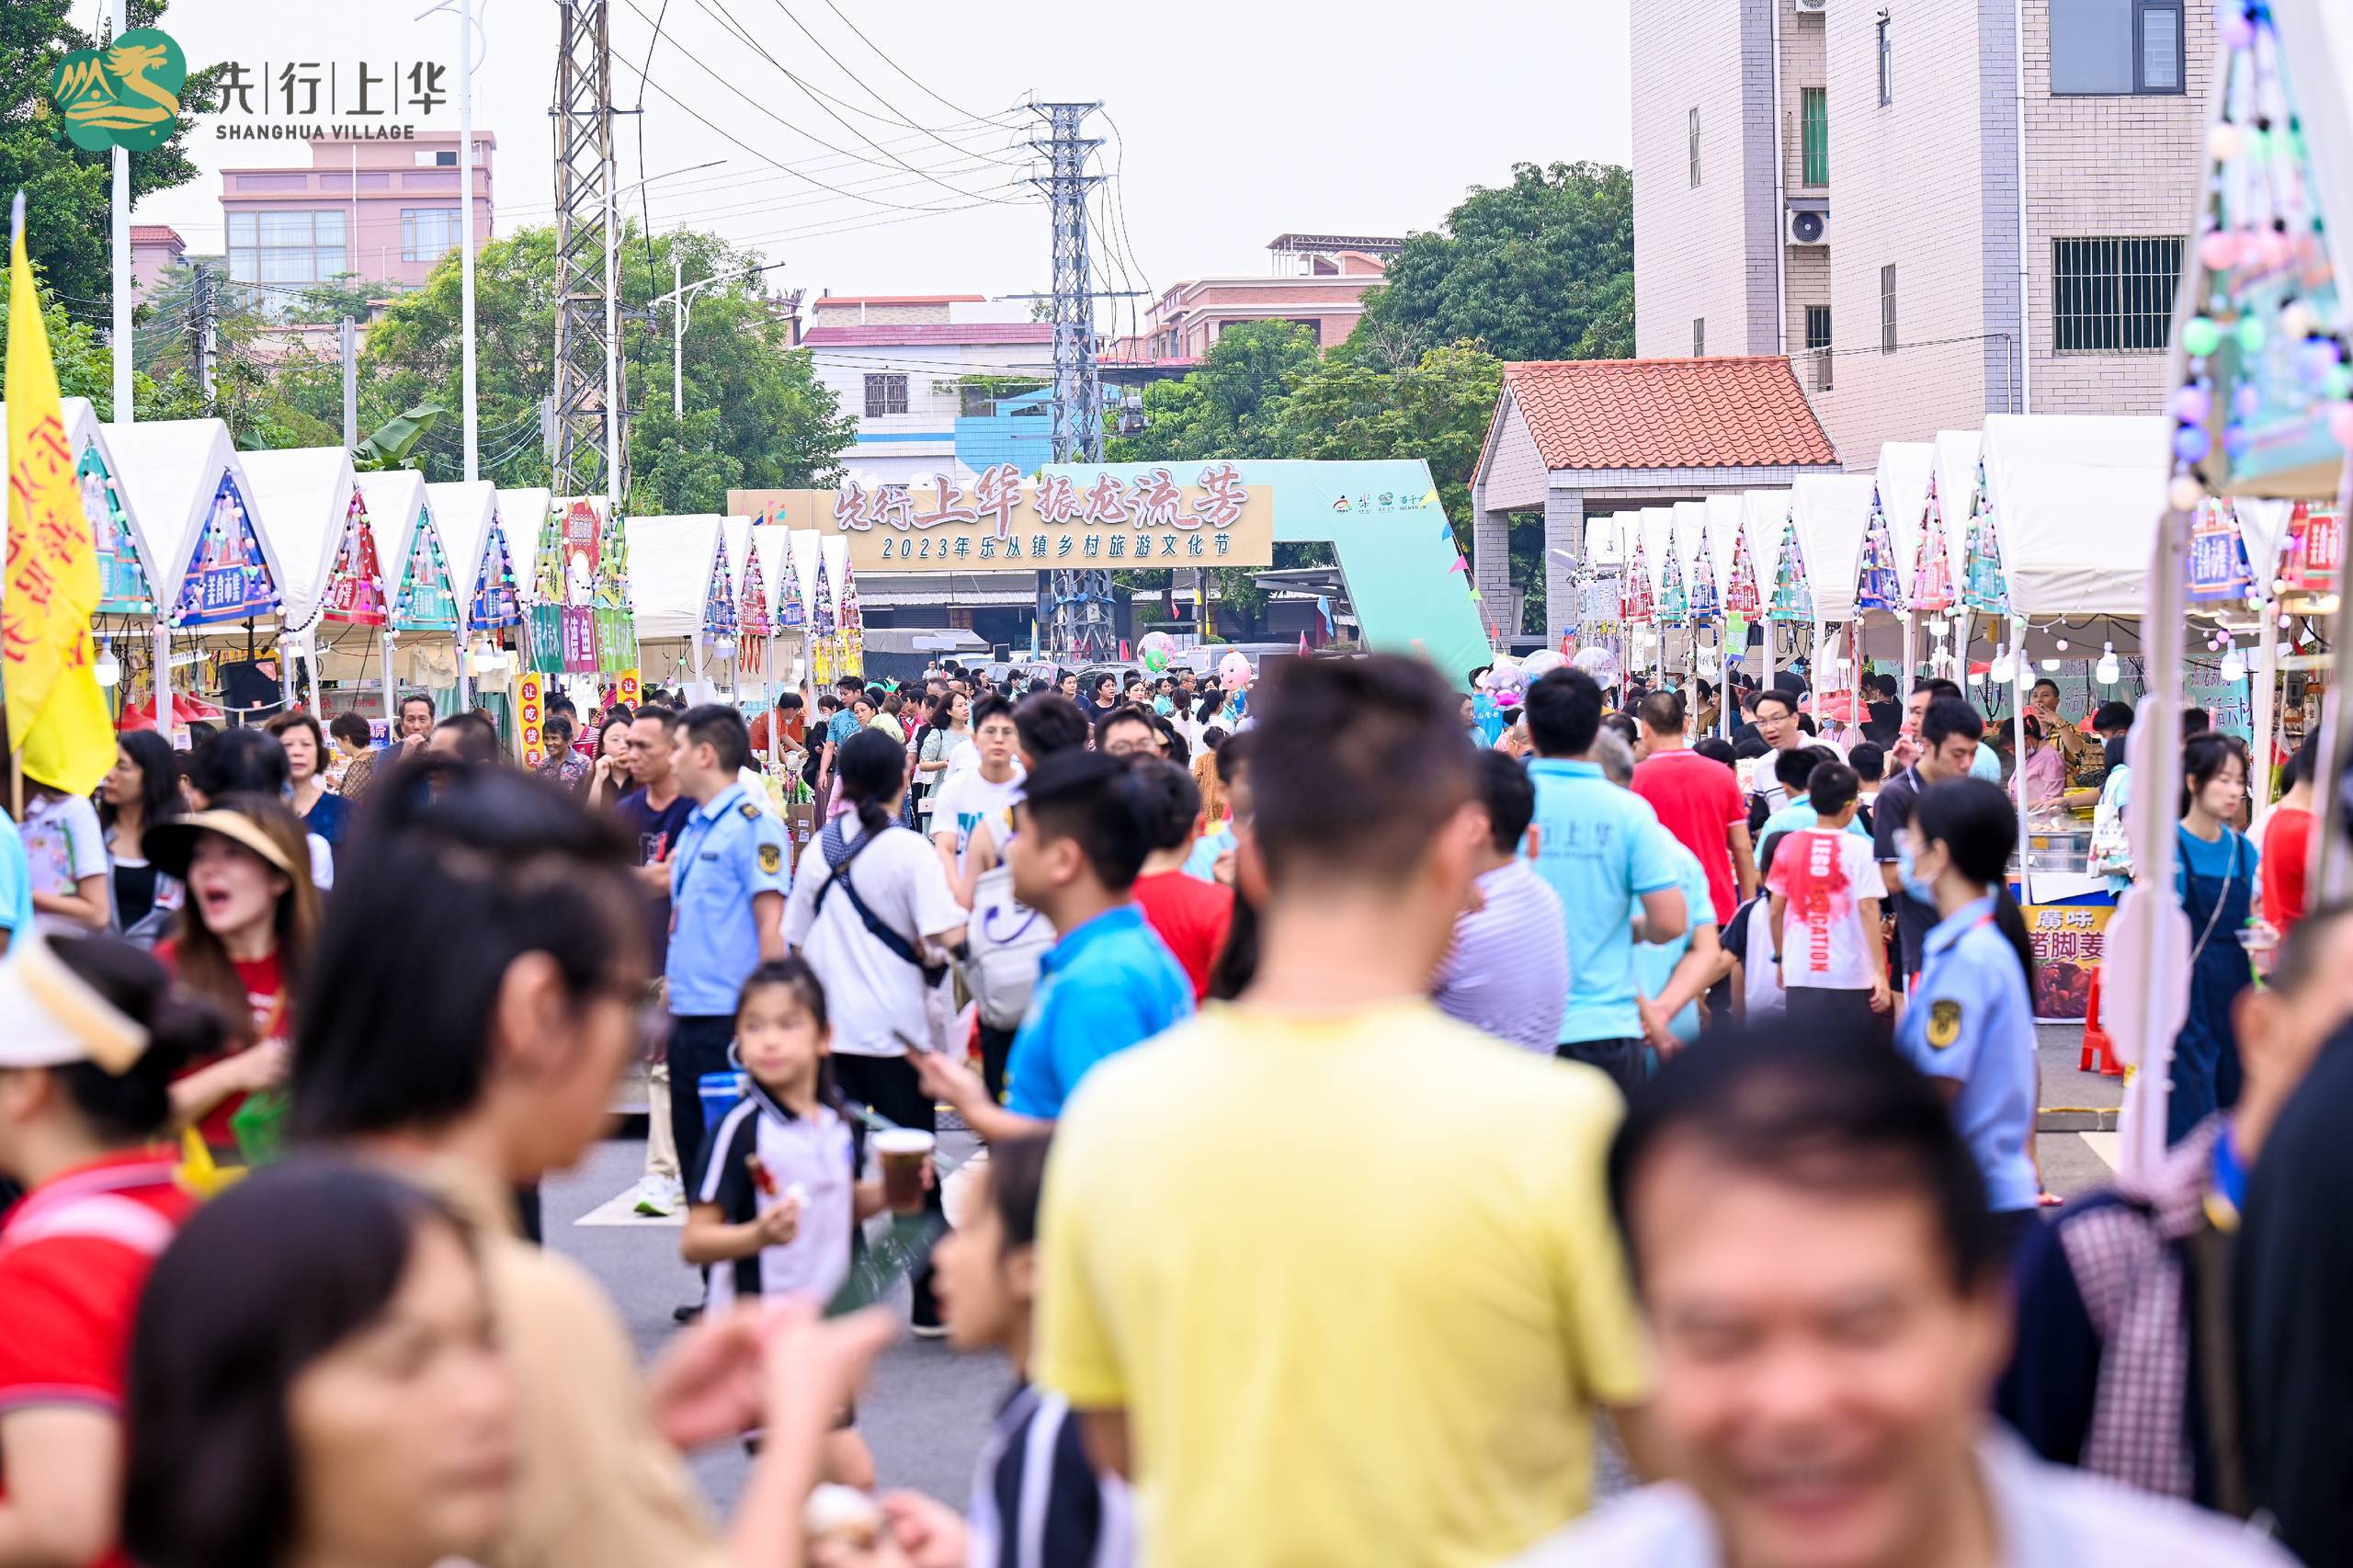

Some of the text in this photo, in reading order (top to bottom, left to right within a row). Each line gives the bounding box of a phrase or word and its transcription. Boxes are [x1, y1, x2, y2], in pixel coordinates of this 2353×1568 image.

[835, 462, 1248, 540] 先行上华 振龙流芳
[882, 533, 1230, 559] 2023年乐从镇乡村旅游文化节
[1809, 838, 1833, 877] LEGO
[2035, 910, 2095, 931] 廣味
